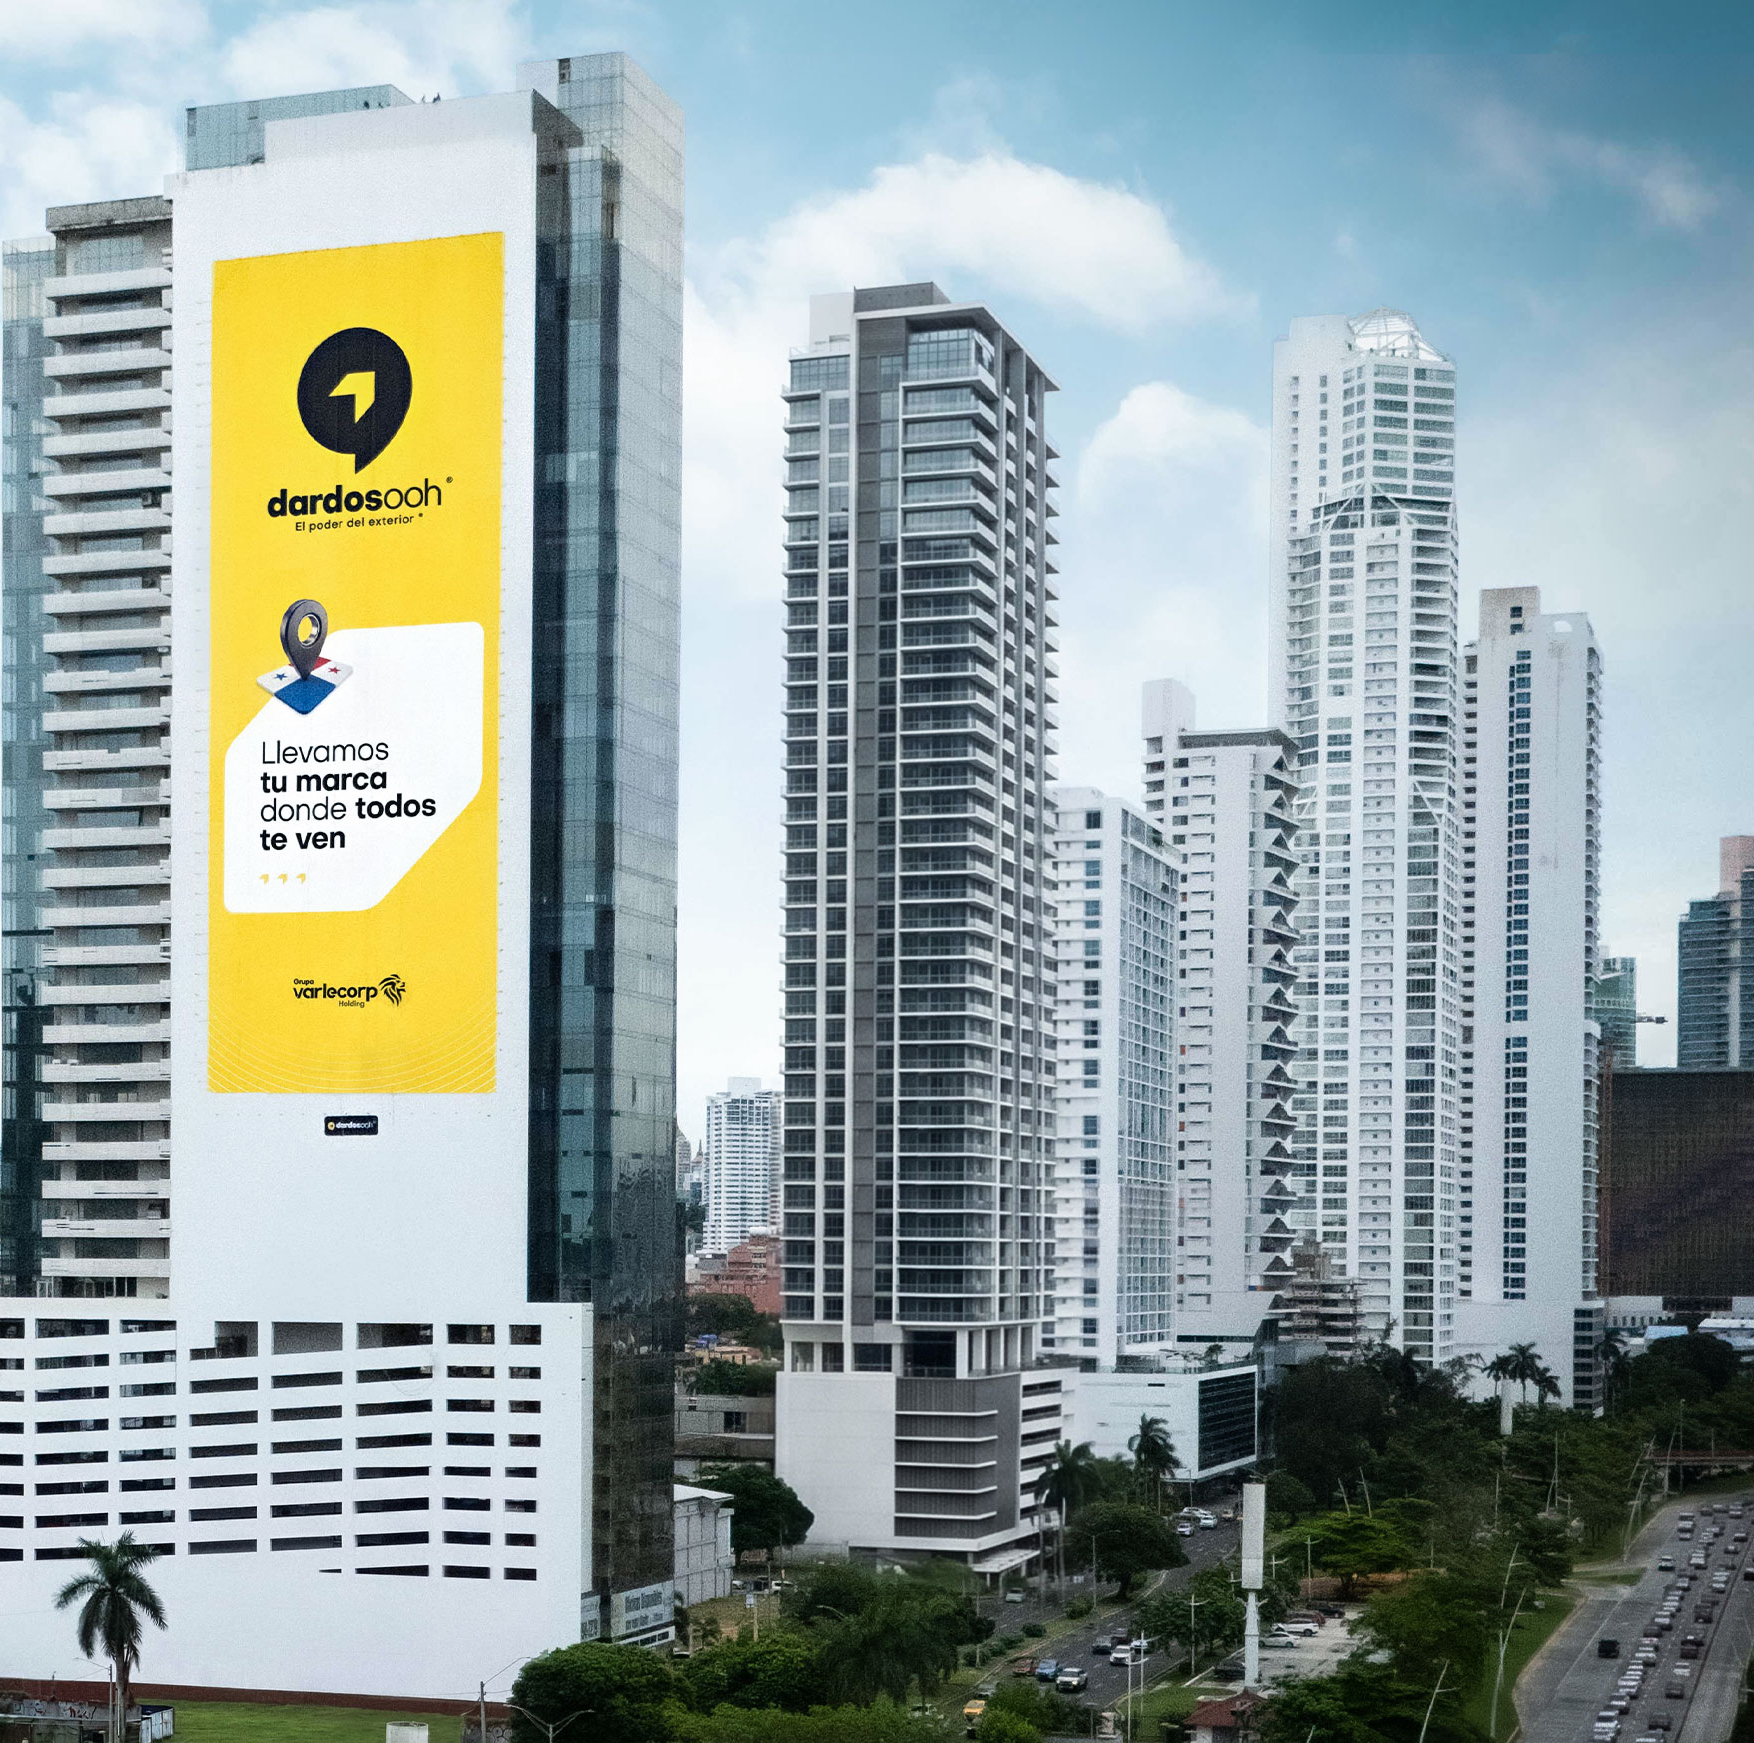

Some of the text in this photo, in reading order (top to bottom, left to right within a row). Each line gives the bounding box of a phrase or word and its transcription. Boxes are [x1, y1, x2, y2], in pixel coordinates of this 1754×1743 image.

[295, 514, 414, 533] El poder del exterior
[262, 740, 389, 764] Llevamos
[260, 771, 387, 793] tu marca
[260, 793, 437, 822] donde todos
[260, 829, 346, 851] te ven
[338, 1000, 365, 1008] Holding
